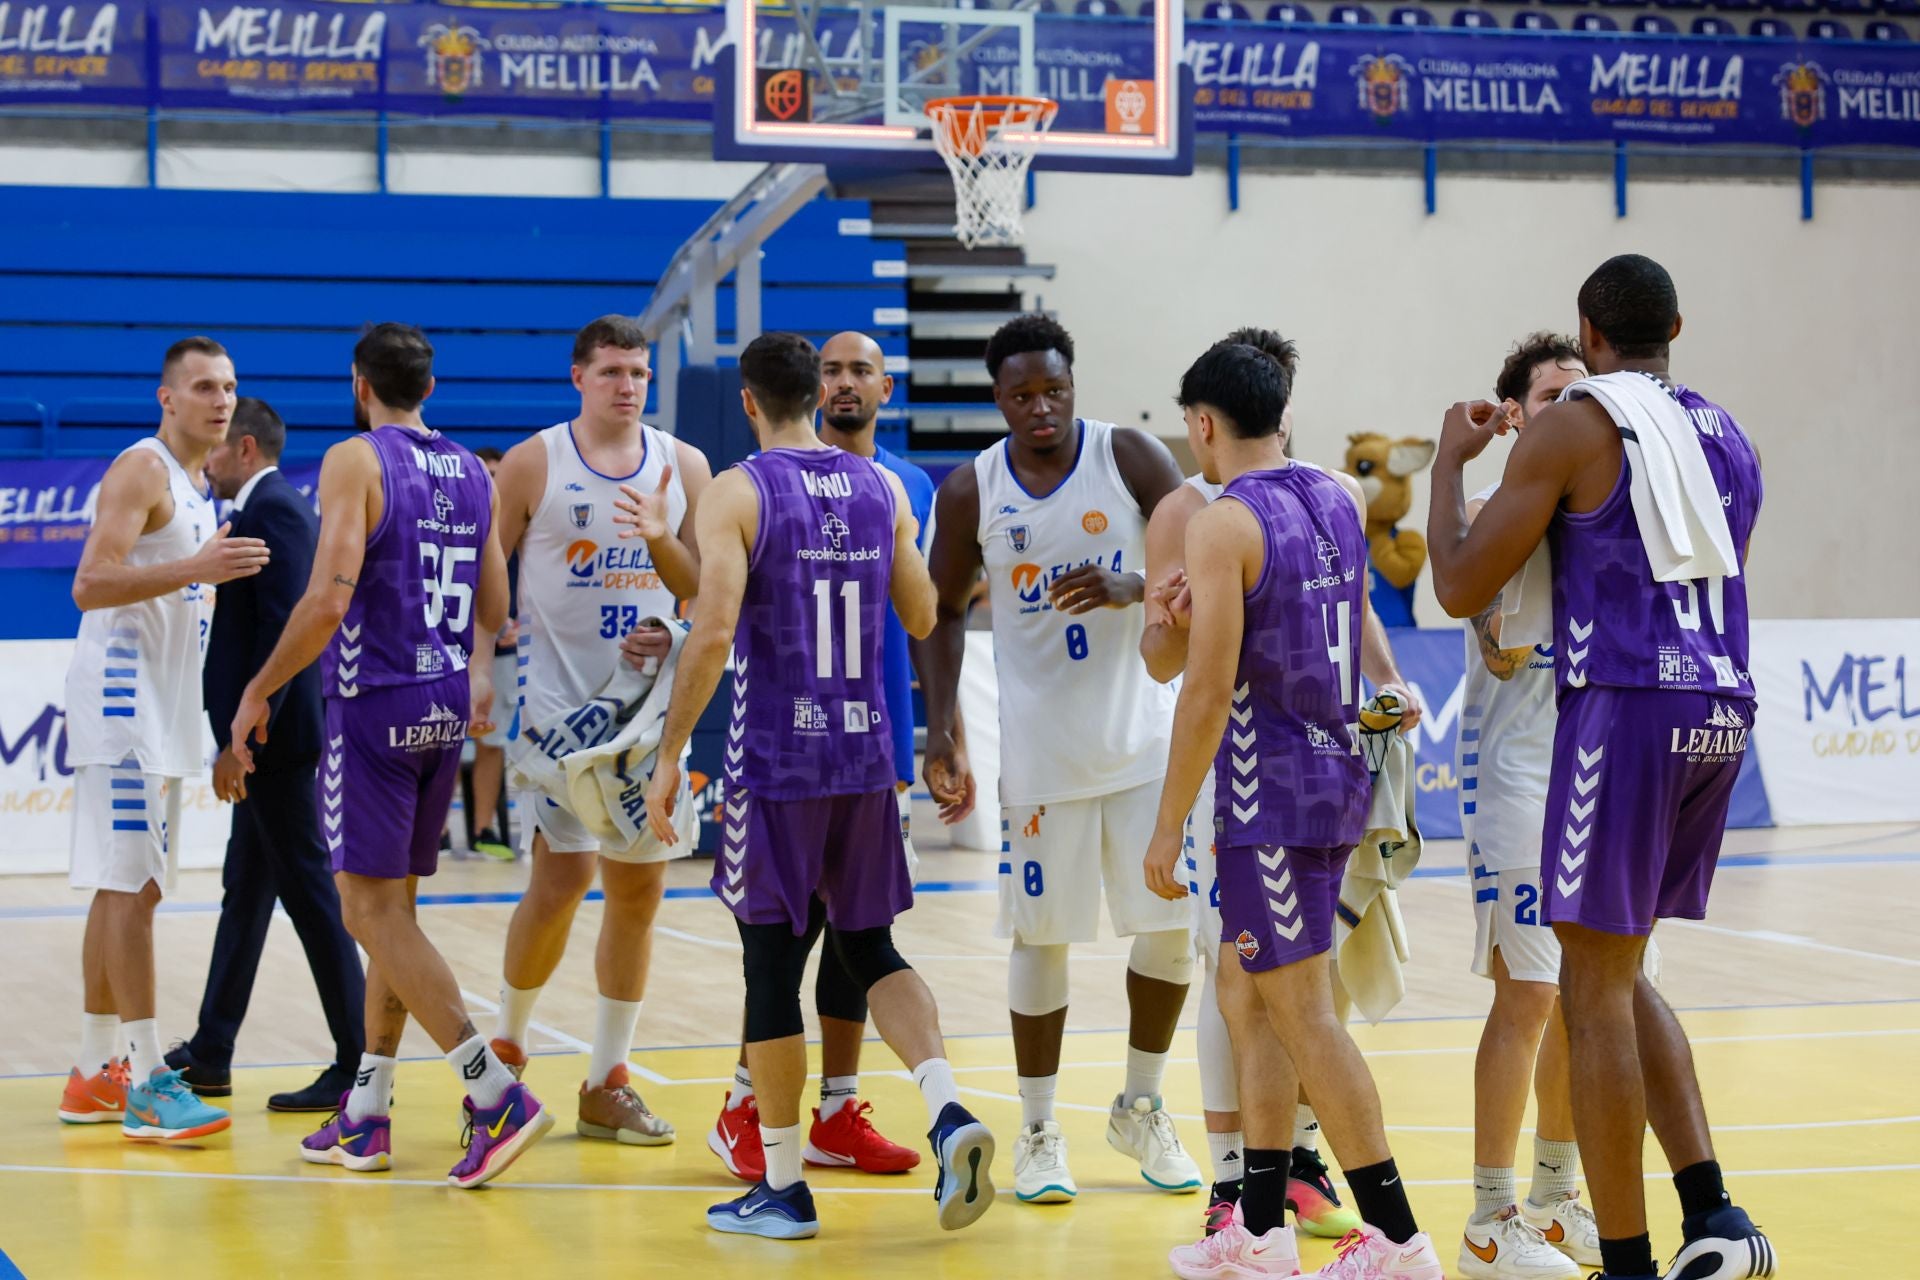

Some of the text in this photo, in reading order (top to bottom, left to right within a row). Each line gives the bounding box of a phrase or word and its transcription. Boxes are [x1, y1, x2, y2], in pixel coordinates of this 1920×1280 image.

[195, 6, 387, 59] MELILLA
[494, 34, 558, 51] CIUDAD
[500, 54, 660, 91] MELILLA
[1418, 59, 1469, 74] CIUDAD
[1590, 51, 1744, 99] MELILLA
[1424, 78, 1563, 114] MELILLA
[800, 470, 852, 499] MANU
[797, 546, 881, 561] recoletas salud
[419, 542, 477, 634] 35
[600, 605, 638, 639] 33
[813, 579, 862, 679] 11
[1066, 623, 1089, 660] 0
[1321, 600, 1352, 705] 4
[1682, 655, 1693, 663] PA
[1682, 664, 1700, 673] LEN
[1682, 673, 1699, 682] CIA
[813, 712, 828, 721] LEN
[813, 721, 828, 729] CIA
[1812, 728, 1896, 759] CIUDAD
[1024, 860, 1045, 897] 0
